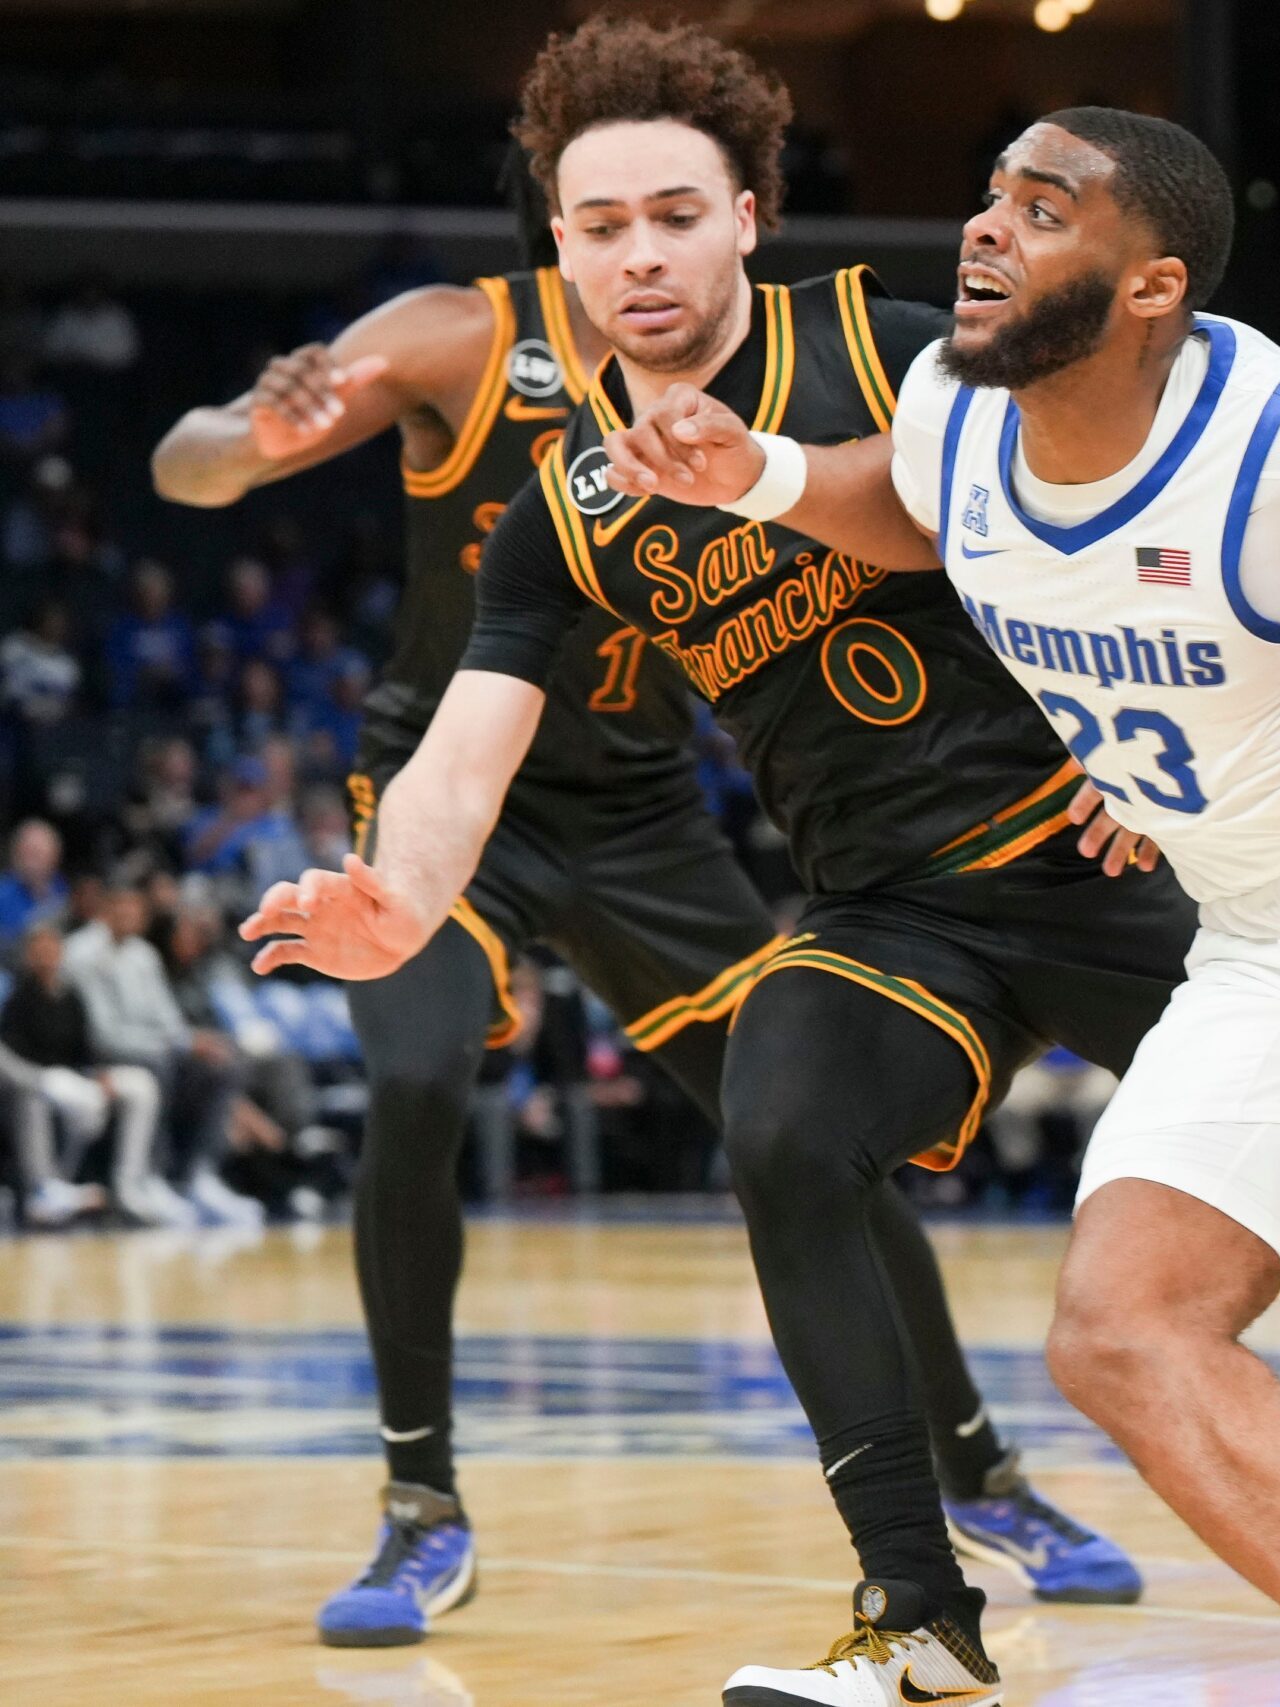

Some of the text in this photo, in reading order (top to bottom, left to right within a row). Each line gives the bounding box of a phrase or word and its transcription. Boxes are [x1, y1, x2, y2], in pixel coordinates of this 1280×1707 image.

[634, 521, 776, 624] San
[587, 626, 646, 712] 1
[964, 591, 1226, 690] Memphis
[1037, 689, 1208, 814] 23
